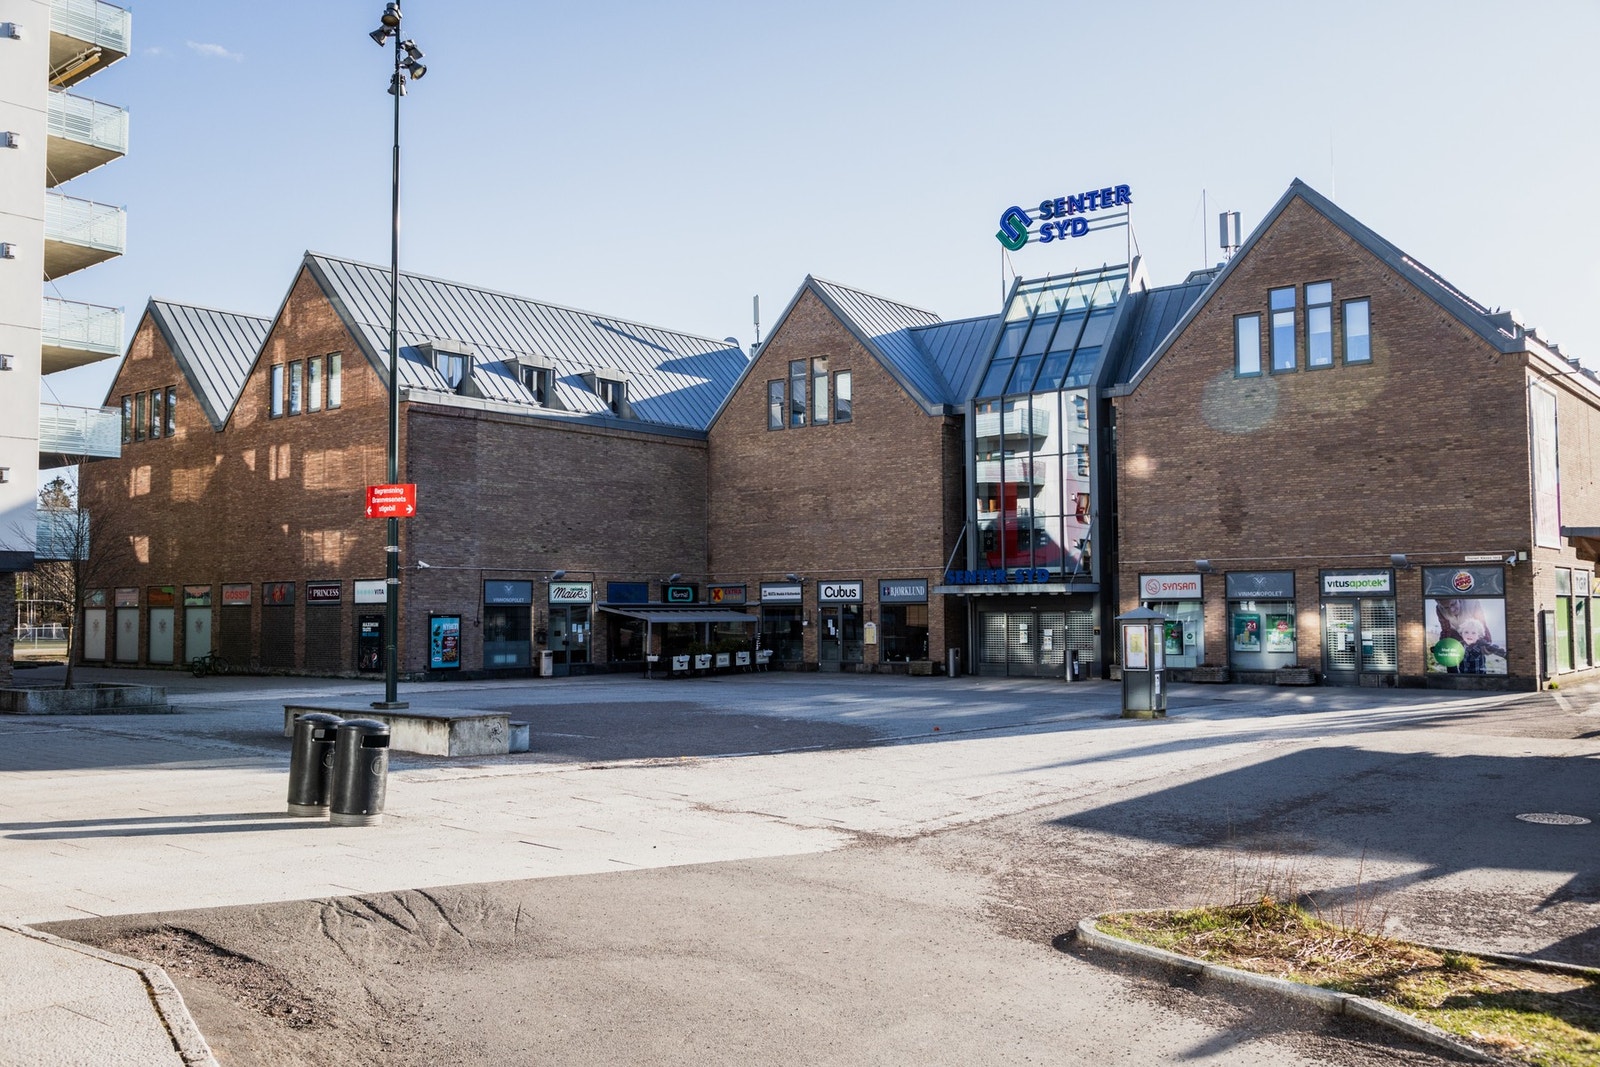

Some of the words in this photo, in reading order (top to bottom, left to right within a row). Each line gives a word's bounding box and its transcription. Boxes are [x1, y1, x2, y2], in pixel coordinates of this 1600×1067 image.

[1039, 184, 1132, 220] SENTER
[1039, 216, 1090, 243] SYD
[945, 569, 1006, 584] SENTER
[1014, 568, 1050, 583] SYD
[313, 588, 339, 597] PRINCESS
[825, 586, 856, 598] Cubus
[1162, 582, 1197, 591] SYNSAM
[224, 590, 250, 600] GOSSIP
